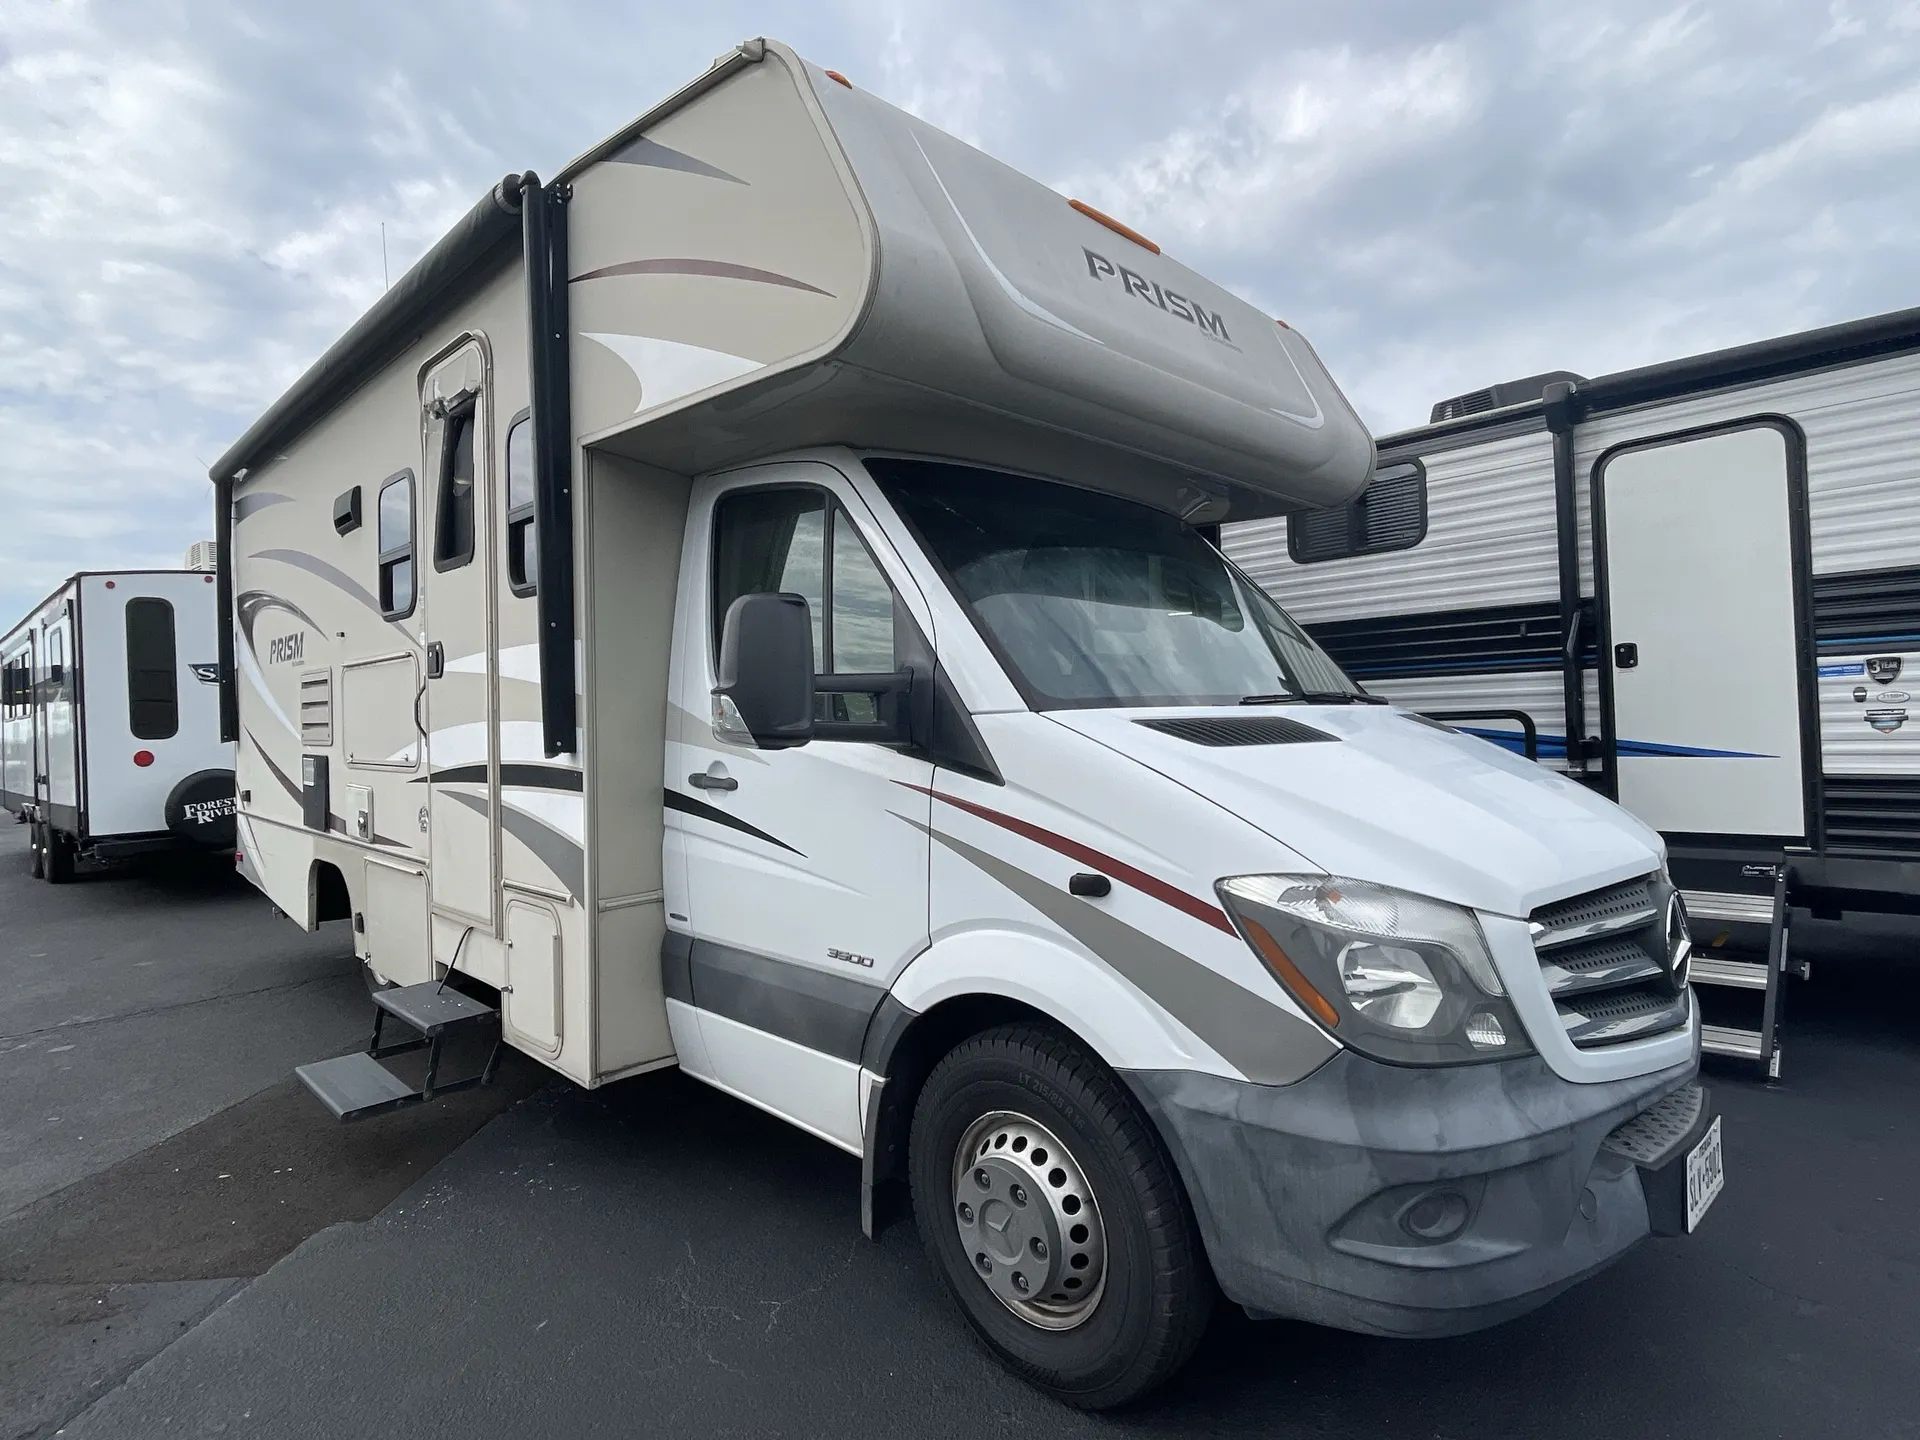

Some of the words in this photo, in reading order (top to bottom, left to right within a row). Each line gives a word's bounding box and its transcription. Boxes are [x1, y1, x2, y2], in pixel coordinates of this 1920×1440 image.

[1081, 245, 1231, 342] PRISM
[269, 631, 304, 665] PRISM
[1870, 659, 1881, 674] 3
[827, 947, 874, 968] 3500
